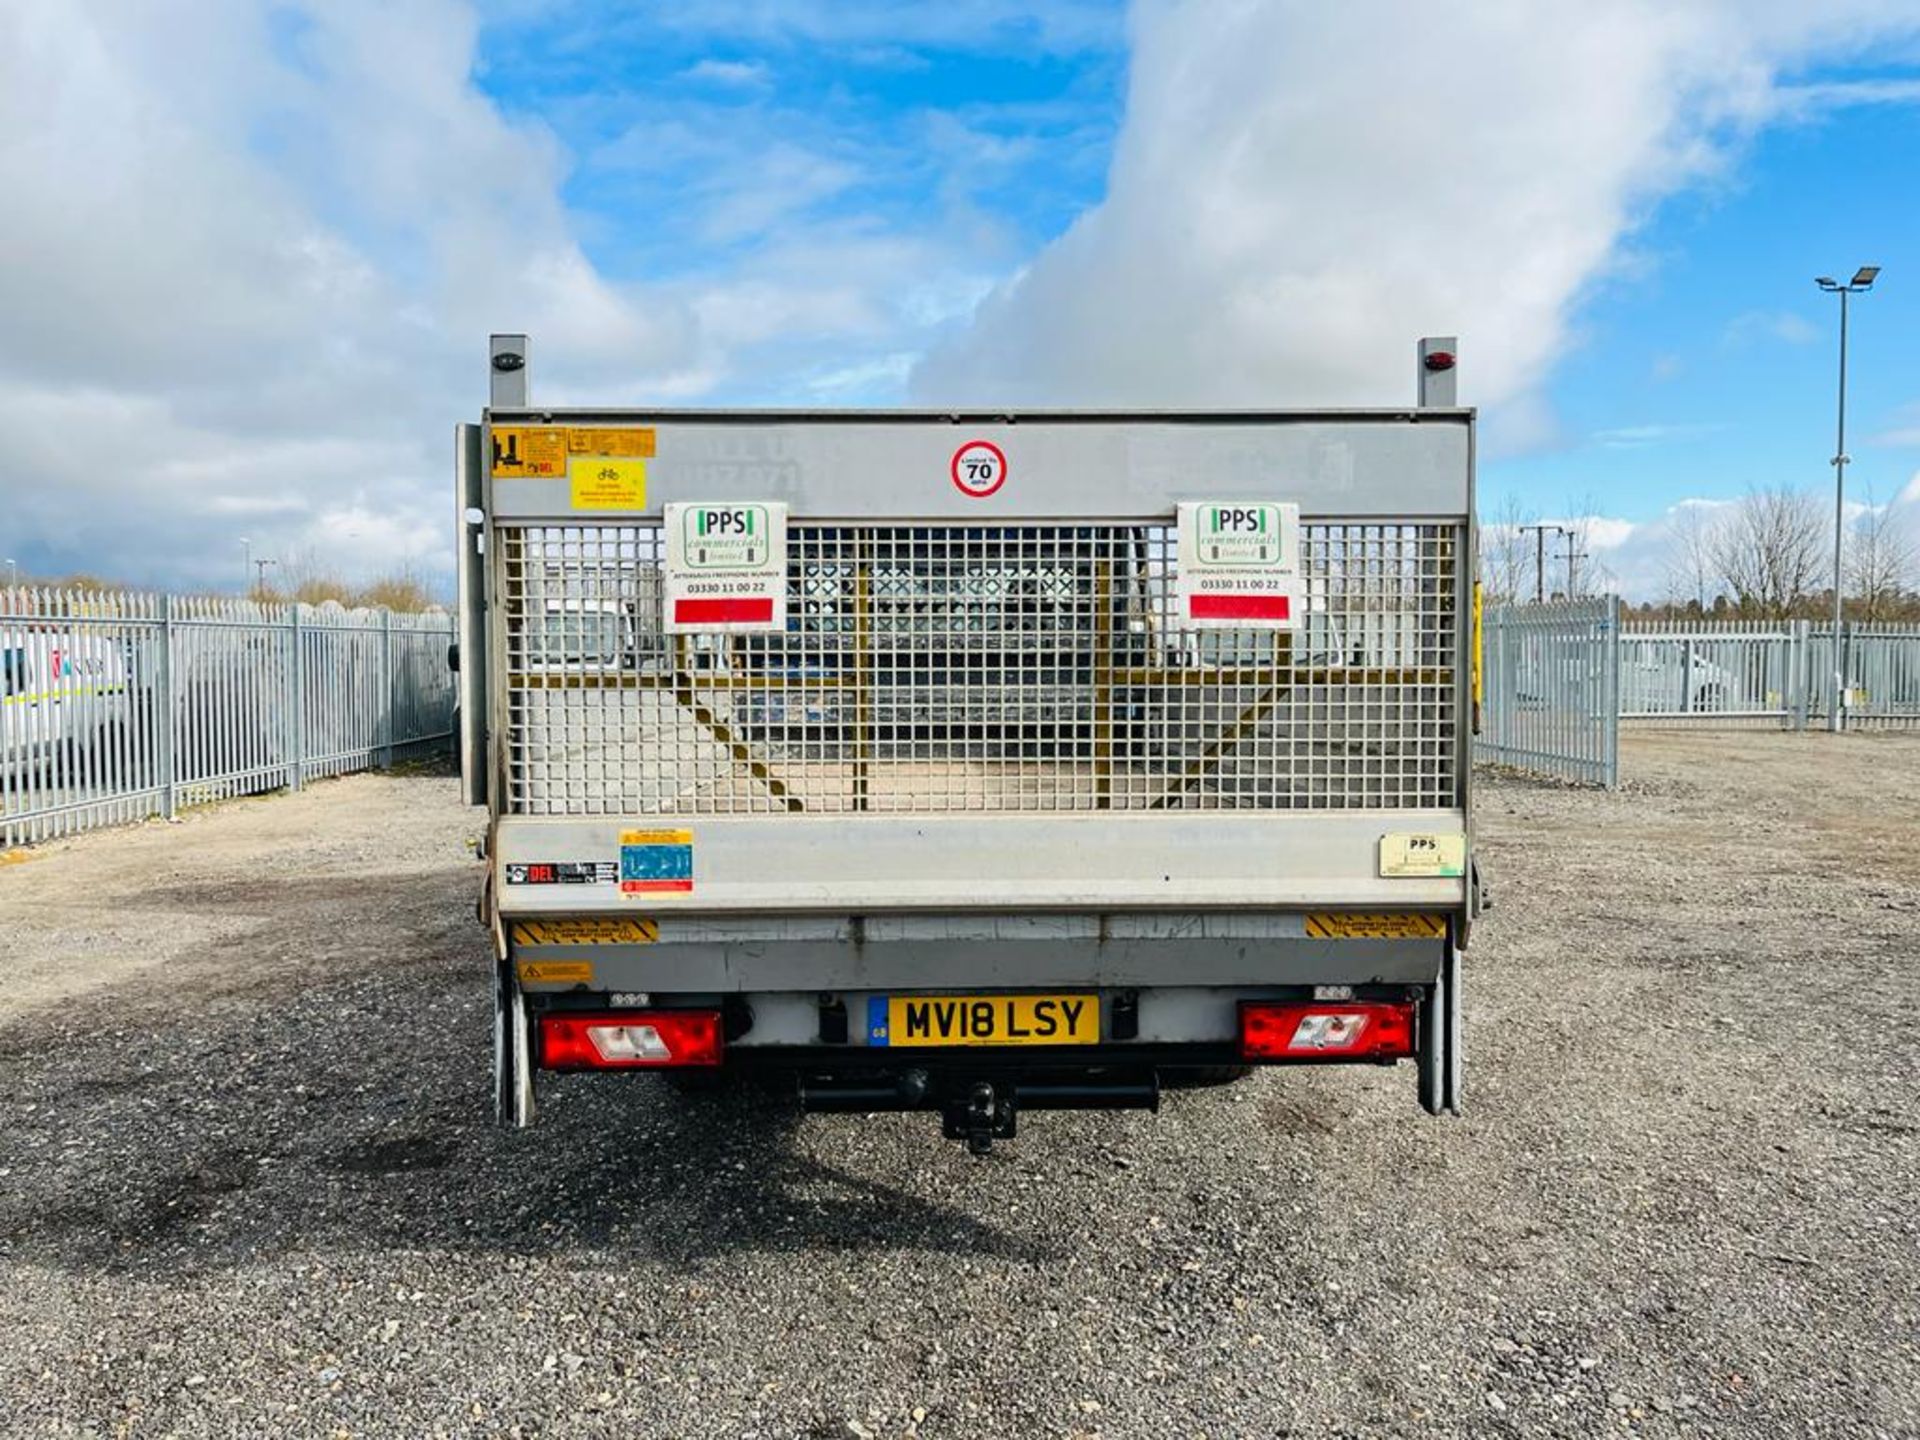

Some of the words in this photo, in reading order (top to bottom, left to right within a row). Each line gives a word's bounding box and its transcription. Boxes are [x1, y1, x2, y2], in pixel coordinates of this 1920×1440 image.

[966, 464, 992, 479] 70
[706, 511, 746, 534] PPS
[1219, 509, 1258, 531] PPS
[688, 535, 764, 549] commercials
[1201, 533, 1276, 545] commercials
[687, 584, 719, 593] 03330
[722, 583, 734, 592] 11
[736, 583, 751, 592] 00
[752, 583, 766, 592] 22
[1201, 580, 1233, 589] 03330
[1236, 580, 1248, 589] 11
[1250, 580, 1264, 589] 00
[1266, 580, 1279, 589] 22
[1410, 839, 1436, 850] PPS
[528, 865, 555, 882] DEL
[906, 1002, 995, 1038] MV18
[1007, 1000, 1084, 1037] LSY
[872, 1028, 887, 1038] GB
